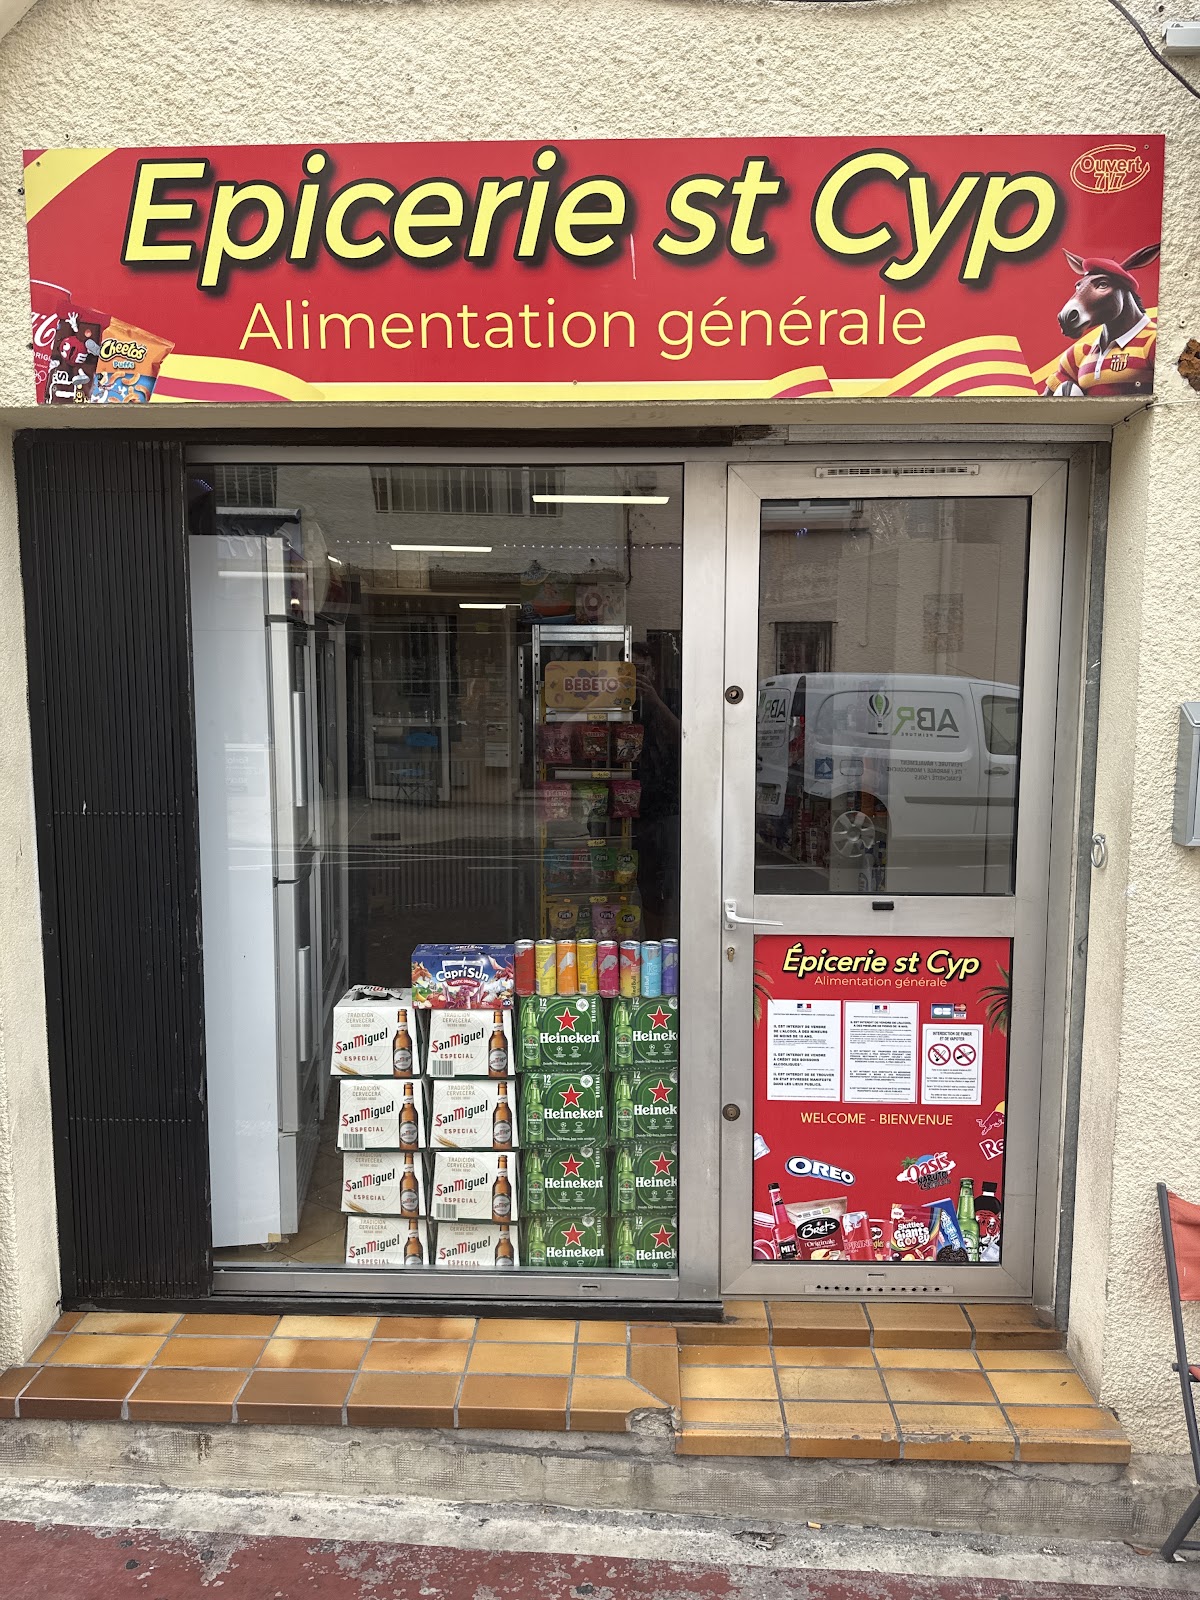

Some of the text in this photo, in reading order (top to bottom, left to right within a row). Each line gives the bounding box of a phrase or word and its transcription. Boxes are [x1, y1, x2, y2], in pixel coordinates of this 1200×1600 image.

[1080, 155, 1142, 174] Ouvert
[1094, 171, 1126, 193] 7j/7
[121, 148, 1058, 289] Epicerie st Cyp
[239, 295, 925, 360] Alimentation générale
[100, 340, 147, 361] Cheetos
[113, 361, 135, 369] Puffs
[564, 678, 619, 692] BEBETO
[782, 943, 980, 980] Épicerie st Cyp
[814, 975, 948, 988] Alimentation générale
[539, 998, 547, 1006] 12
[540, 1031, 600, 1044] Heineken
[633, 1030, 678, 1042] Heinek
[543, 1075, 551, 1083] 12
[544, 1108, 603, 1119] Heineken
[800, 1112, 866, 1124] WELCOME
[879, 1113, 953, 1126] BIENVENUE
[787, 1157, 855, 1185] OREO
[907, 1153, 951, 1183] Oasis
[545, 1178, 603, 1189] Heineken
[898, 1221, 924, 1230] Skittles
[894, 1226, 930, 1240] Giants
[547, 1247, 604, 1258] Heineken
[781, 1244, 796, 1254] MIX
